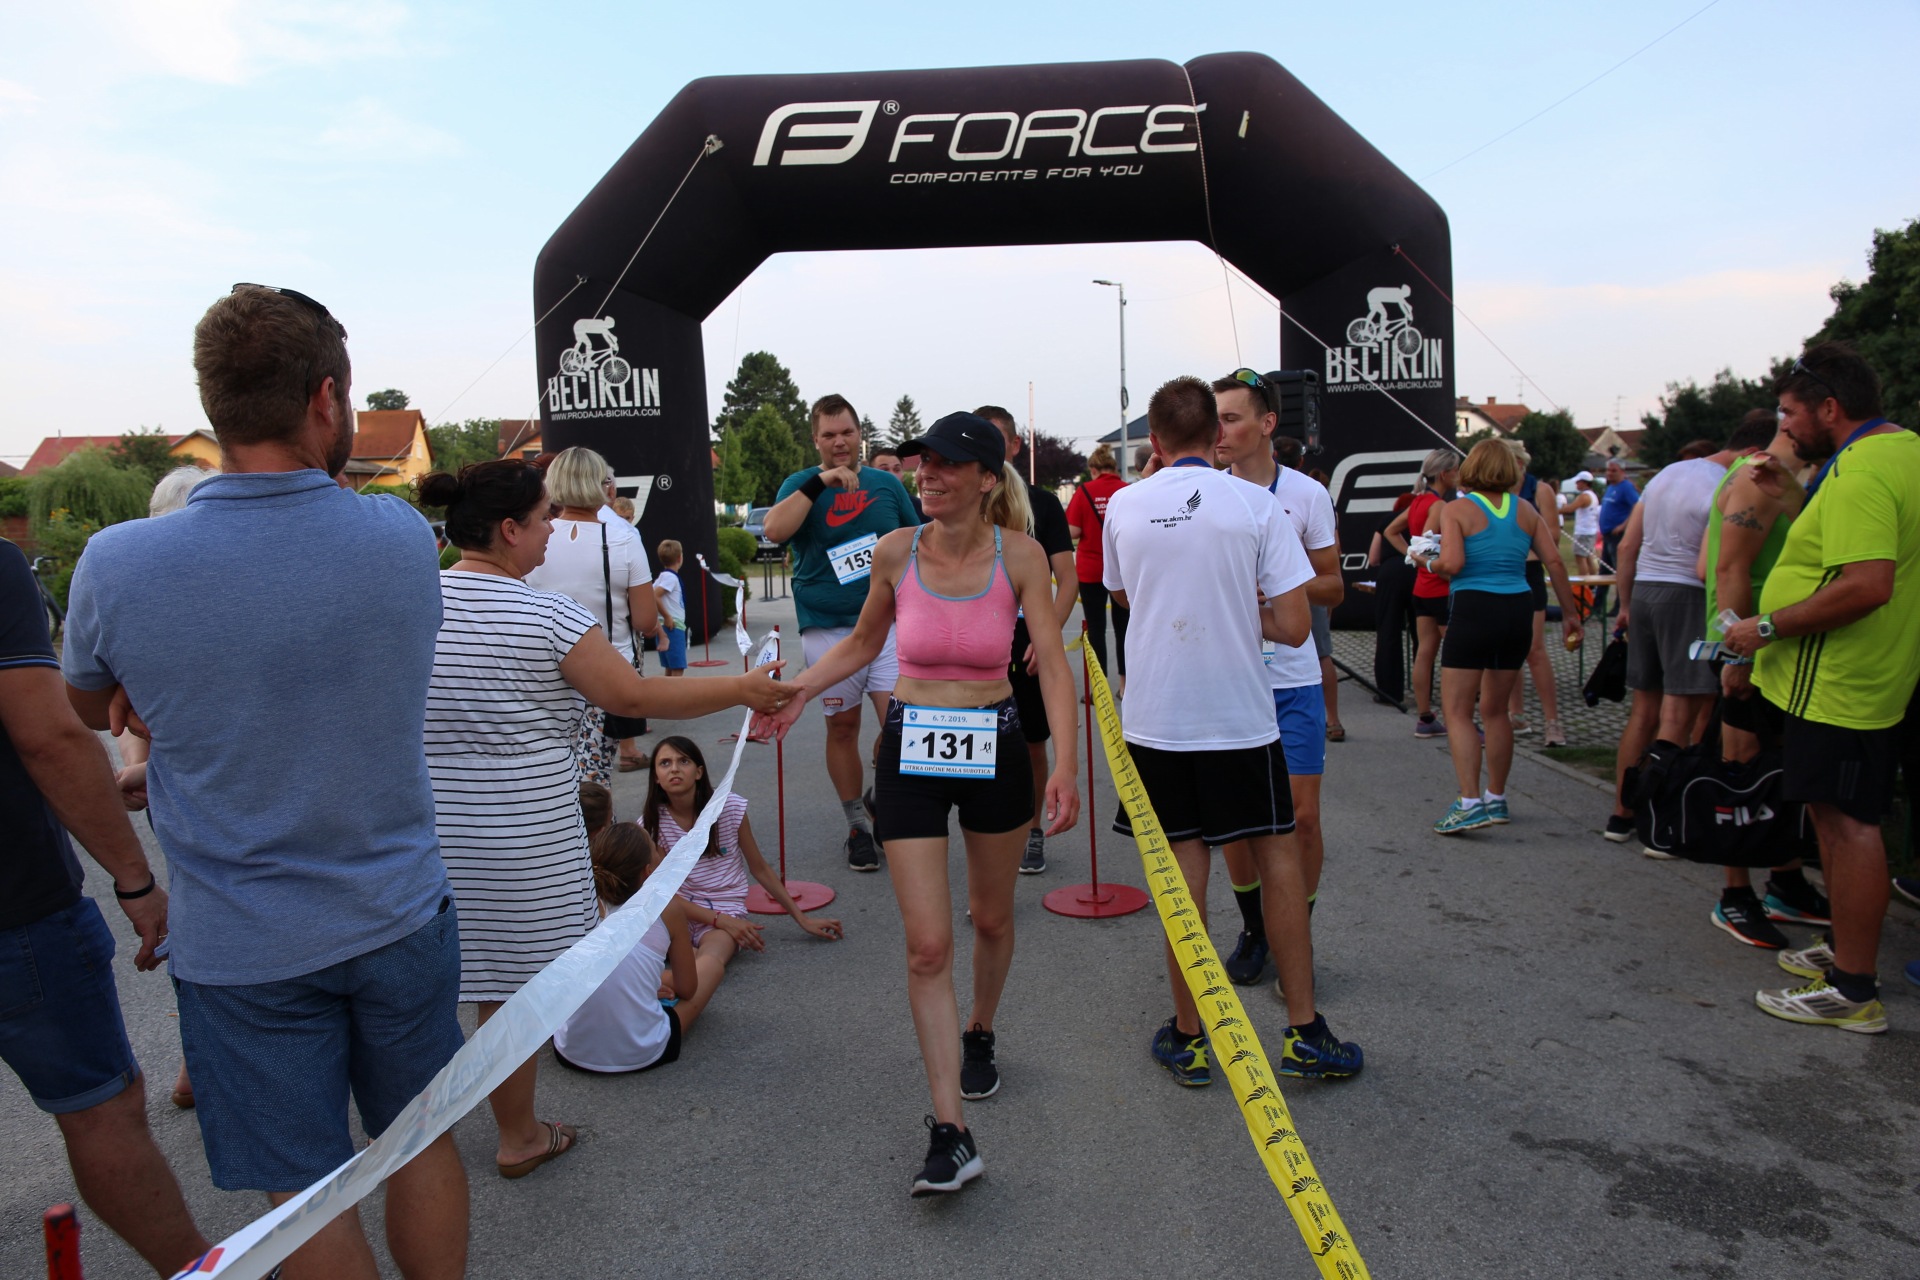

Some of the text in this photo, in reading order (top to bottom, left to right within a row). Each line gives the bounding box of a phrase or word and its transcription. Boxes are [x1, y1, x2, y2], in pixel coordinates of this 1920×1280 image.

[888, 103, 1207, 163] FORCE
[889, 164, 1144, 184] COMPONENTS FOR YOU
[1327, 380, 1443, 393] WWW.PRODAJA-BICIKLA.COM
[551, 408, 661, 421] WWW.PRODAJA-BICIKLA.COM
[833, 490, 869, 511] NIKE
[1150, 514, 1192, 524] www.akm.hr
[844, 549, 873, 571] 153
[922, 731, 974, 761] 131
[1714, 803, 1775, 827] FILA
